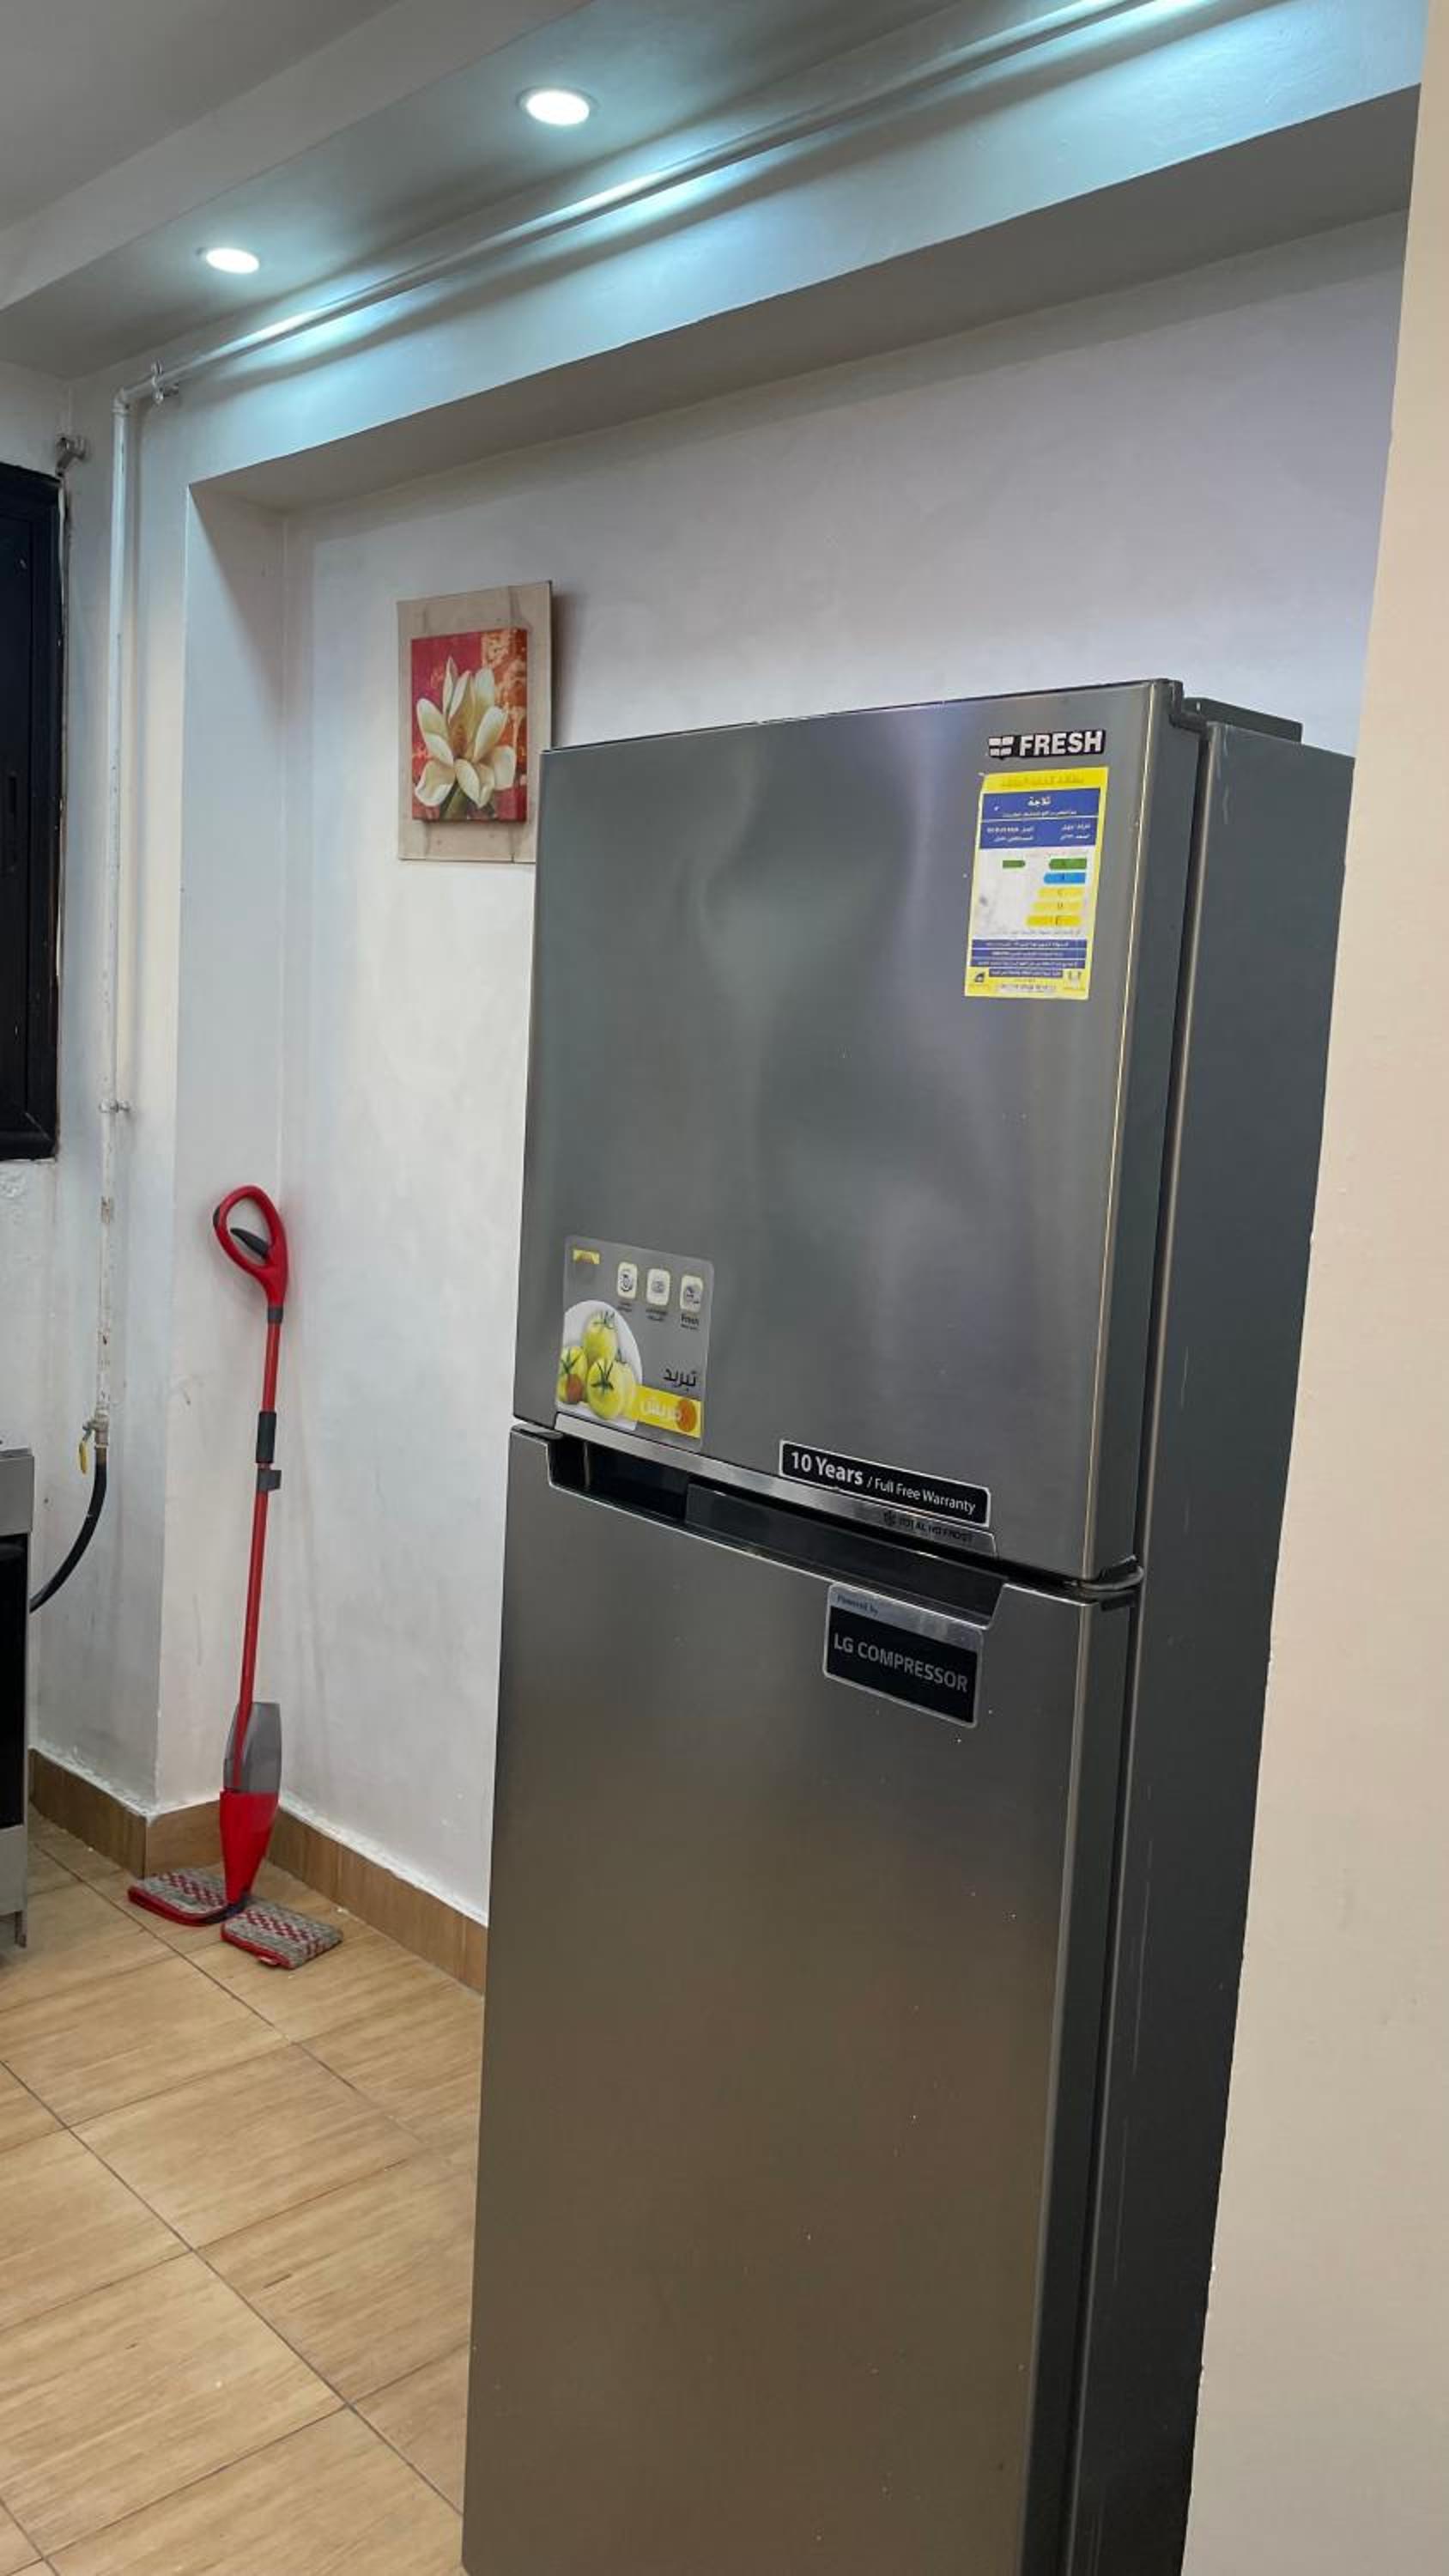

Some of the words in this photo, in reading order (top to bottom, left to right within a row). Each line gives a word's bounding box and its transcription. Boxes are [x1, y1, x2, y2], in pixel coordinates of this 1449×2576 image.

[1019, 730, 1104, 757] FRESH
[663, 1368, 697, 1393] تبريد
[791, 1451, 812, 1473] 10
[815, 1455, 864, 1486] Years
[875, 1478, 894, 1494] Full
[896, 1484, 921, 1501] Free
[922, 1490, 976, 1516] Warranty
[834, 1632, 854, 1654] LG
[858, 1641, 968, 1692] COMPRESSOR
